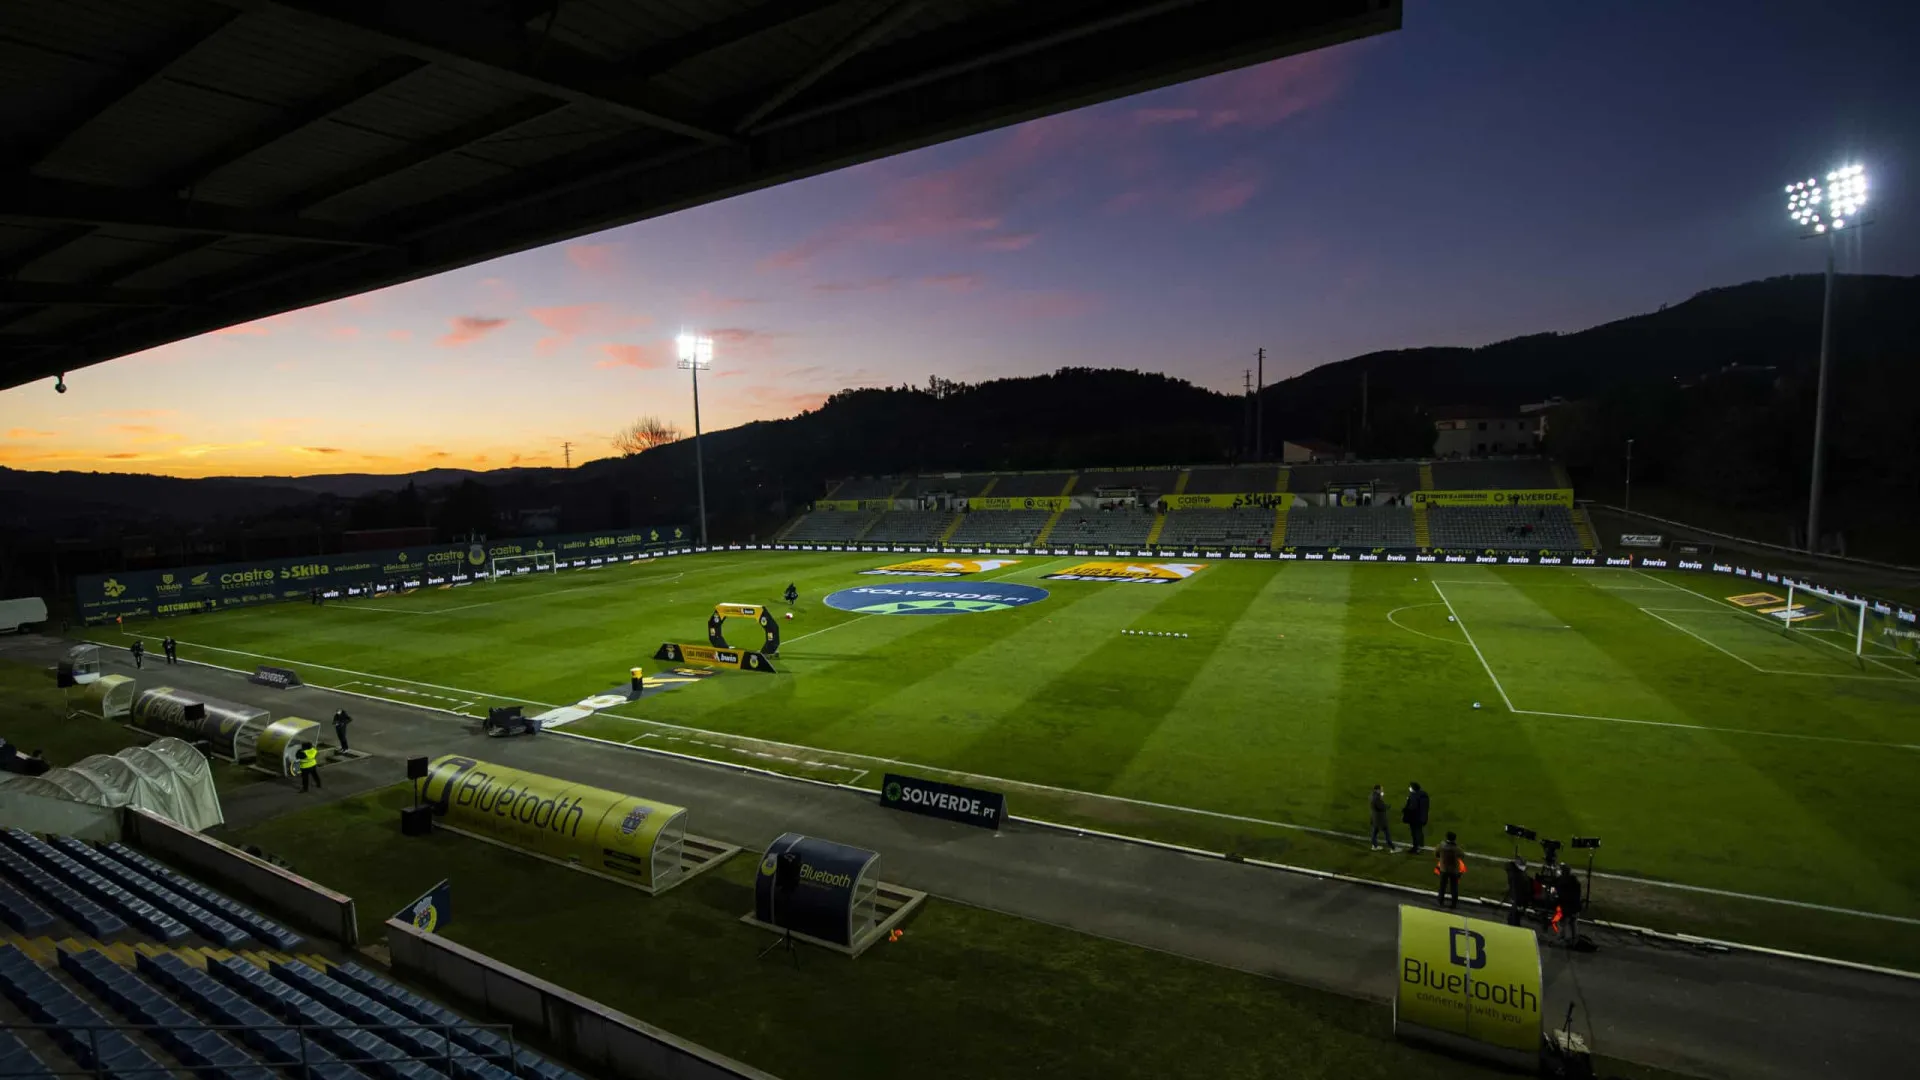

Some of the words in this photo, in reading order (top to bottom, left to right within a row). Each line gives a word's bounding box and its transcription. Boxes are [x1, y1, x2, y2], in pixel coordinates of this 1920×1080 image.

[1253, 551, 1272, 559] bwin
[1304, 552, 1324, 560] bwin
[1331, 552, 1351, 561] bwin
[1359, 553, 1378, 561] bwin
[1386, 554, 1407, 562] bwin
[1415, 554, 1436, 562] bwin
[1445, 554, 1467, 563] bwin
[1475, 555, 1498, 563] bwin
[1507, 555, 1530, 564] bwin
[1539, 556, 1561, 564] bwin
[1571, 556, 1596, 565] bwin
[1606, 557, 1631, 566] bwin
[1642, 558, 1667, 567] bwin
[1678, 560, 1703, 570] bwin
[1712, 563, 1732, 573] bwin
[291, 563, 329, 577] Skita
[220, 568, 275, 584] castro
[474, 571, 490, 579] bwin
[427, 577, 445, 585] bwin
[851, 587, 1030, 603] SOLVERDE.PT
[720, 652, 738, 663] bwin
[456, 771, 585, 839] Bluetooth
[901, 786, 997, 819] SOLVERDE.PT
[799, 863, 852, 888] Bluetooth
[1403, 957, 1538, 1013] Bluetooth
